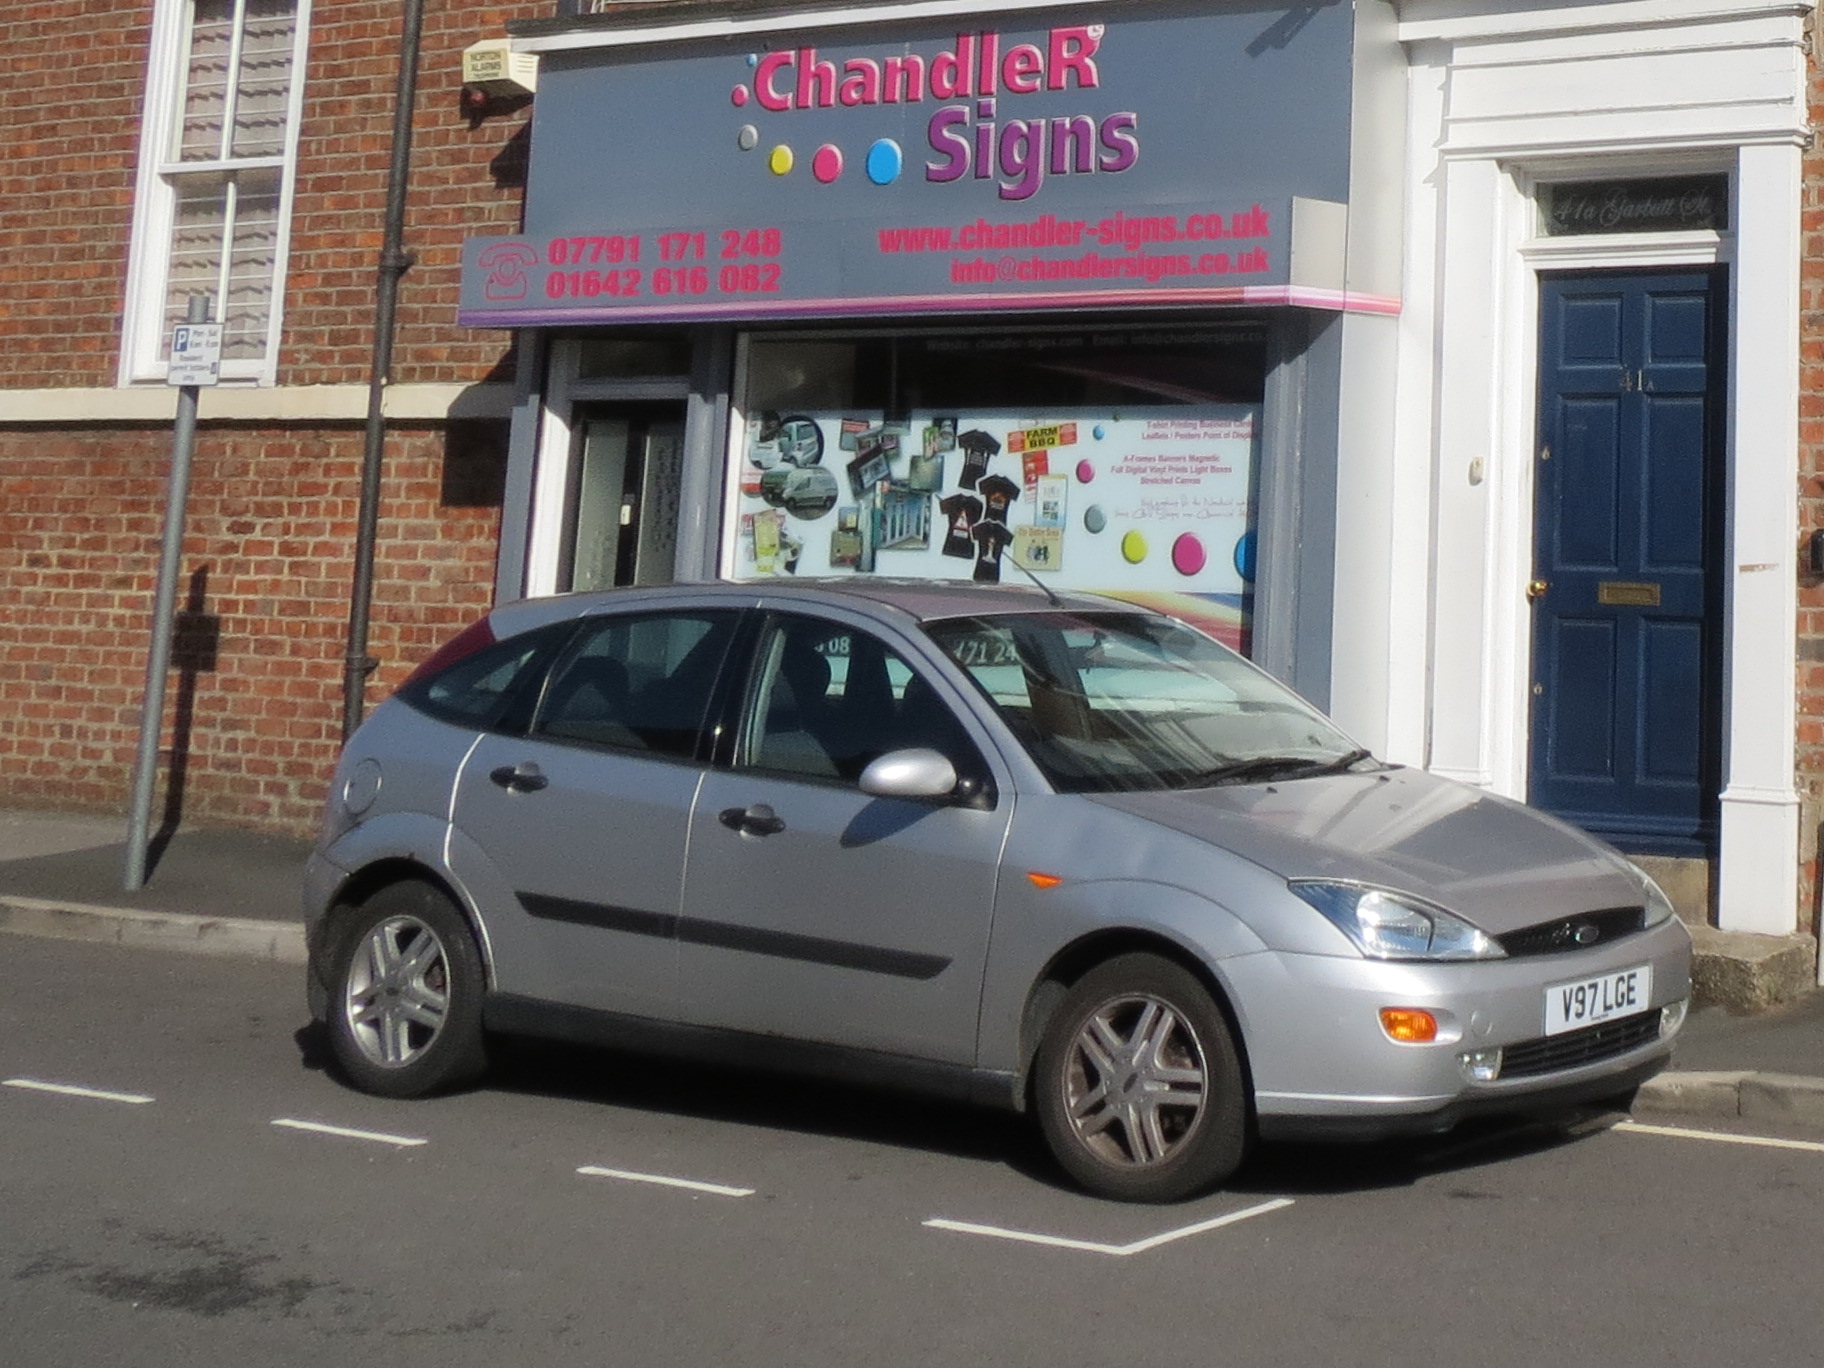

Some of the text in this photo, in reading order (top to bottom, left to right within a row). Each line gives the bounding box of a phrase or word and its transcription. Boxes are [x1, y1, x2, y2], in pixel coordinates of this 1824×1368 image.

[753, 24, 1104, 113] ChandleR
[926, 98, 1139, 203] Signs
[548, 228, 782, 265] 07791 171 248
[877, 204, 1271, 254] www.chandler-signs.co.uk
[546, 263, 781, 299] 01642 616 082
[950, 246, 1269, 284] info@chandlersigns.co.uk
[1027, 426, 1058, 439] FARM
[1029, 436, 1056, 449] BBQ
[1562, 972, 1638, 1022] V97 LGE
